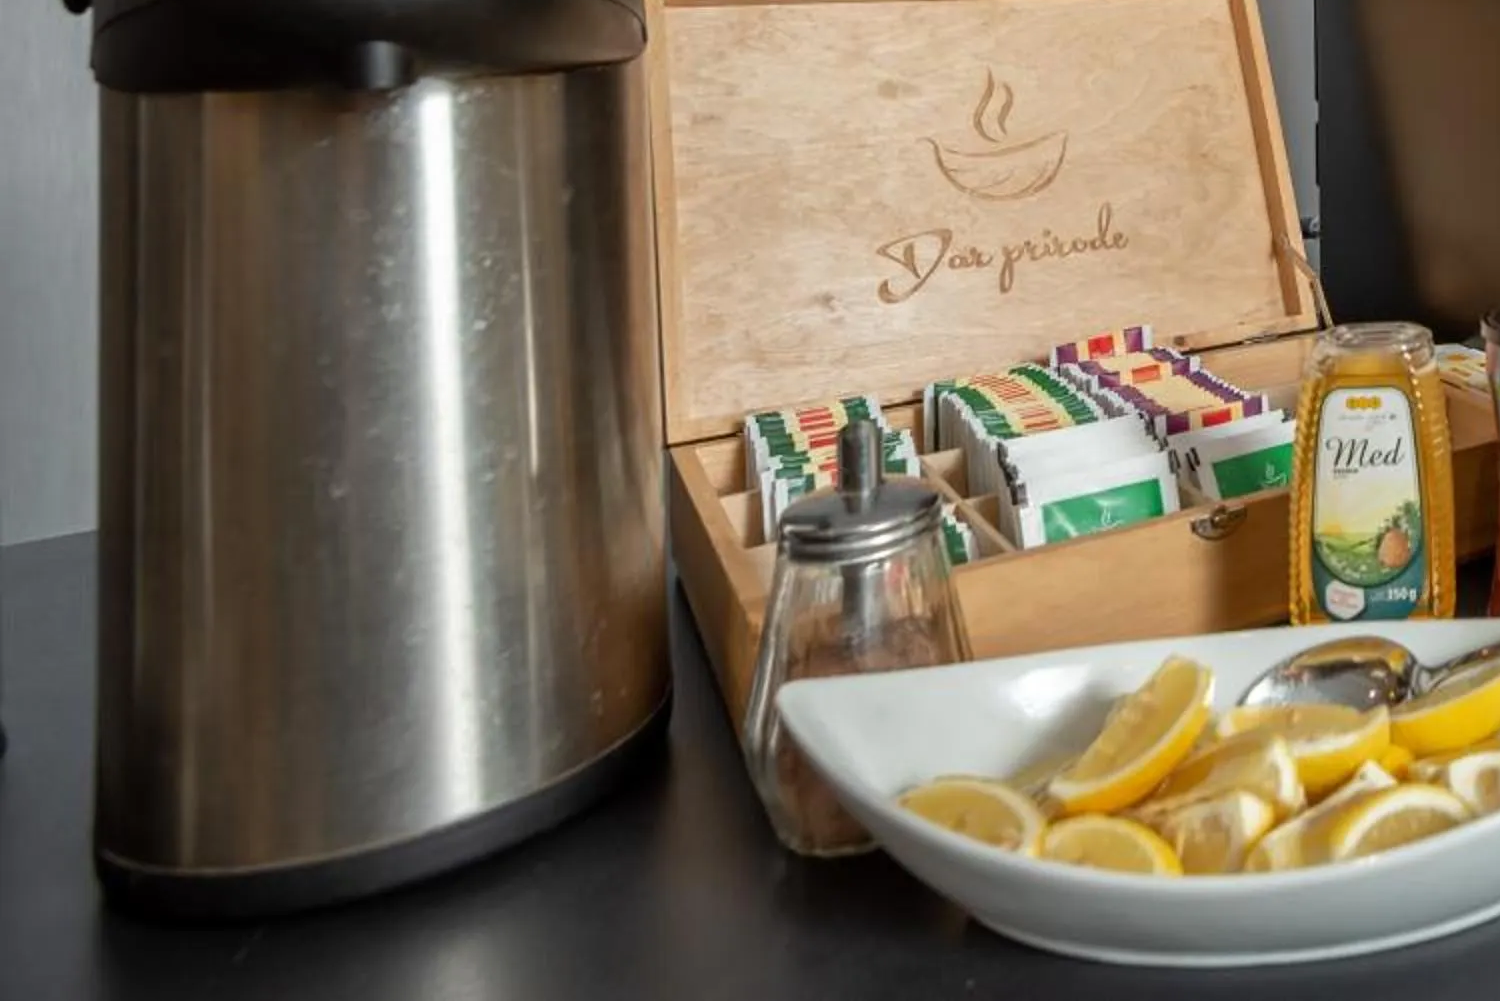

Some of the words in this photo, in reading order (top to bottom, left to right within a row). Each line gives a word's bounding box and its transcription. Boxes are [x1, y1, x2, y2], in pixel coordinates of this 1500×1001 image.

[876, 229, 994, 304] Dar
[999, 201, 1130, 294] prirode
[1325, 435, 1405, 468] Med
